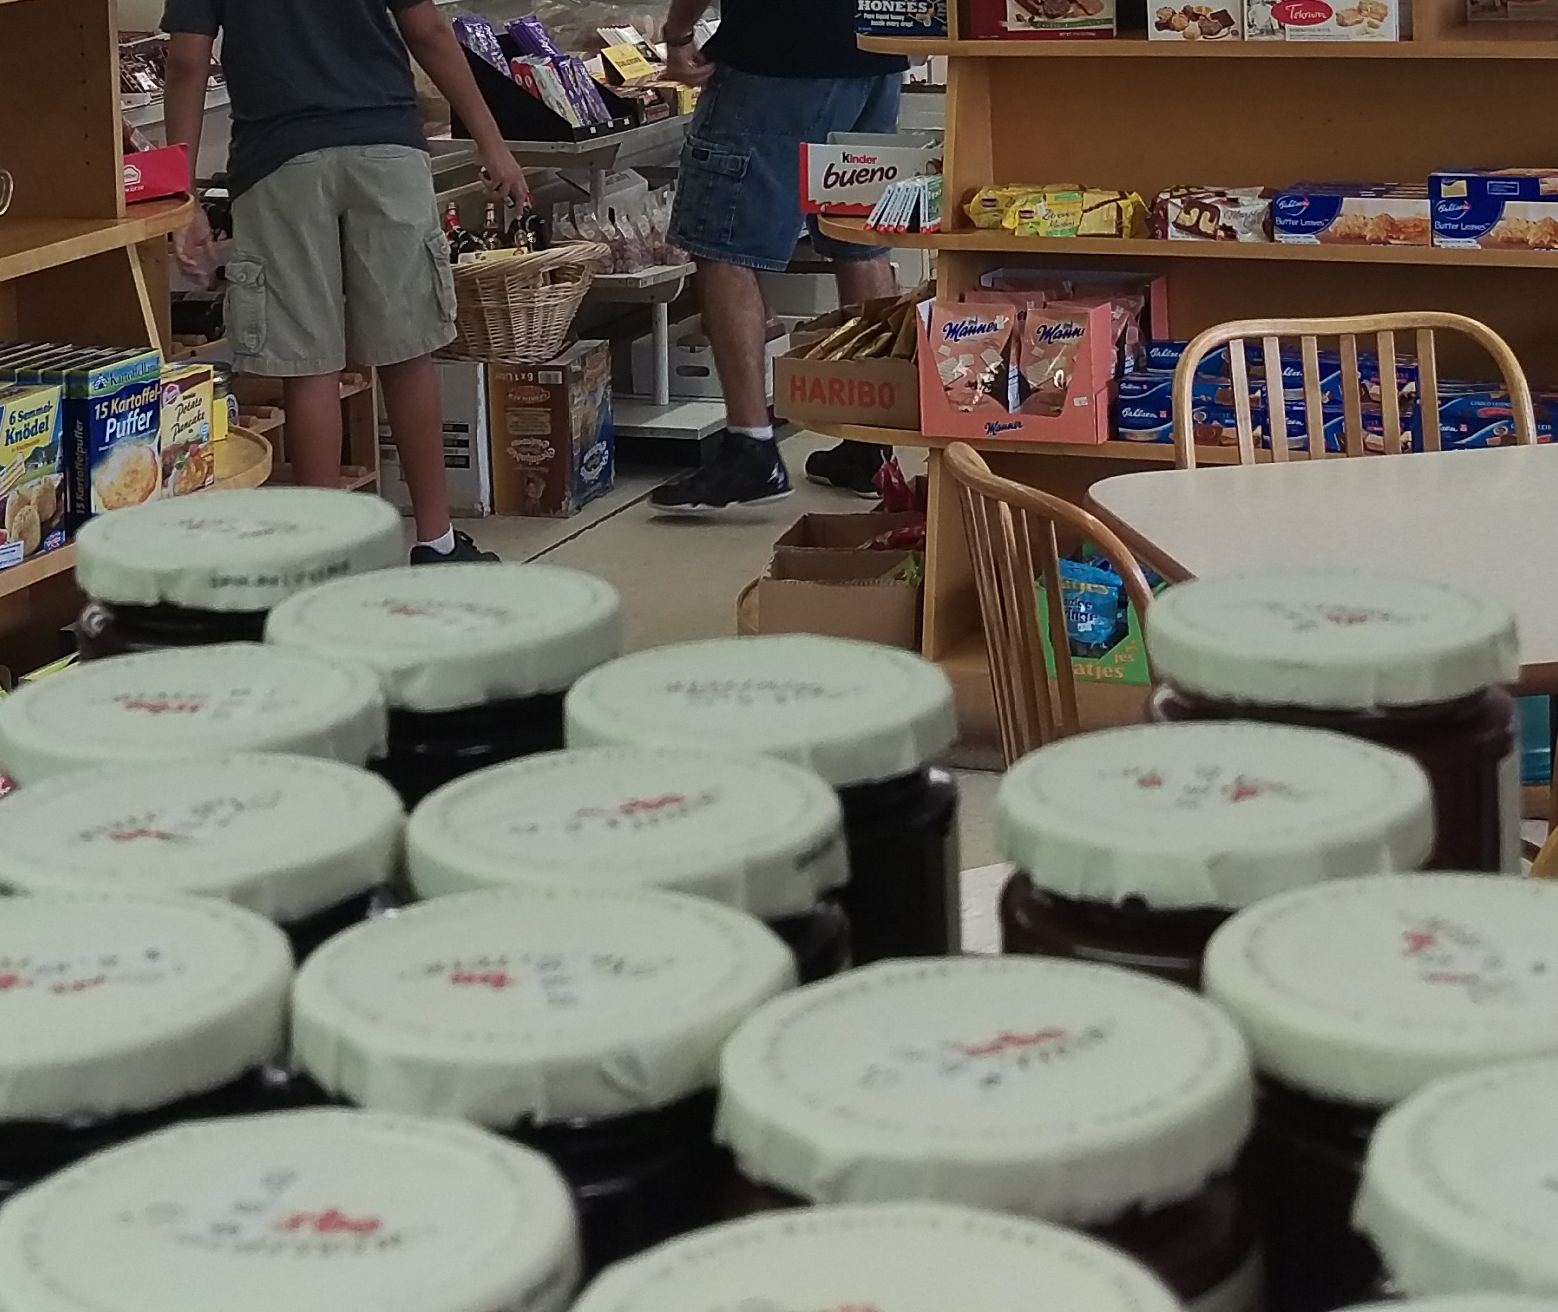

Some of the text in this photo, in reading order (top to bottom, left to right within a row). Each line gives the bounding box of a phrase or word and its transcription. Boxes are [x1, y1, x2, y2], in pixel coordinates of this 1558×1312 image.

[857, 0, 928, 13] HONEES
[876, 12, 890, 20] liquid
[890, 13, 905, 21] honey
[1285, 3, 1326, 20] Tekrum
[886, 20, 900, 28] every
[900, 19, 914, 28] drop!
[842, 151, 878, 165] kinder
[823, 162, 898, 190] bueno
[1275, 217, 1325, 227] Butter Leaves
[1433, 220, 1486, 232] Butter Leaves
[93, 380, 163, 422] 15 Kartoffel-
[789, 374, 896, 411] HARIBO
[8, 400, 54, 426] 6 Semmel-
[174, 396, 203, 419] Potato
[1121, 407, 1158, 419] Bahlsen
[3, 416, 51, 446] Knödel
[105, 410, 154, 443] Puffer
[170, 412, 206, 441] Pancake
[984, 420, 1024, 435] Manner
[74, 417, 86, 501] Kartoffelpuffer
